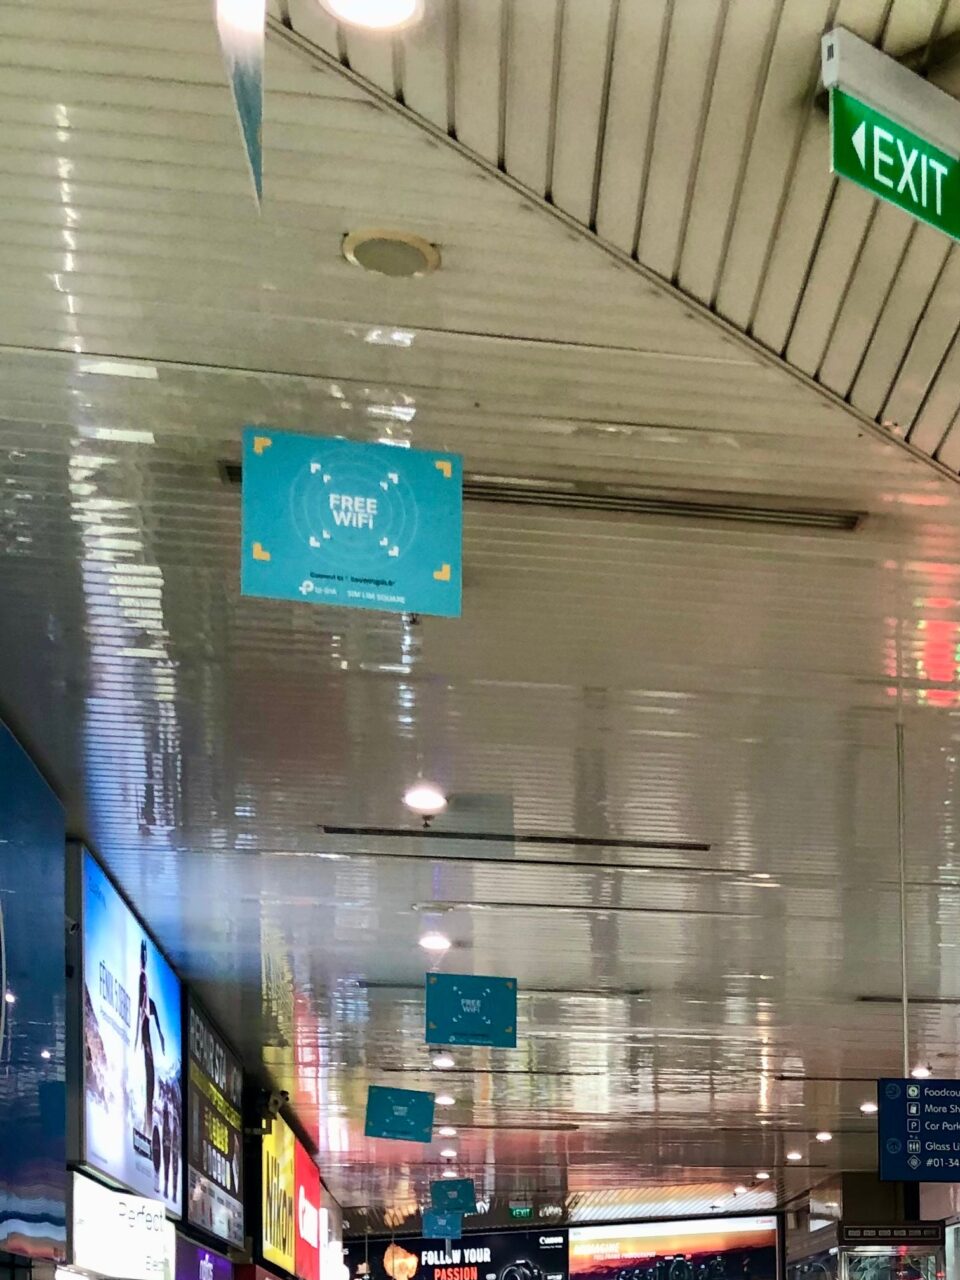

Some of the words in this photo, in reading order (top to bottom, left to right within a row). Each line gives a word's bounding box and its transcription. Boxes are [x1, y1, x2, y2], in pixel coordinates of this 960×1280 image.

[874, 125, 948, 216] EXIT
[329, 493, 378, 515] FREE
[461, 999, 482, 1007] FREE
[924, 1104, 948, 1113] More
[924, 1121, 940, 1130] Car
[925, 1141, 951, 1151] Glass
[926, 1158, 960, 1168] #01-34
[266, 1150, 294, 1258] Nikon
[516, 1208, 530, 1217] EXIT
[463, 1247, 491, 1263] YOUR
